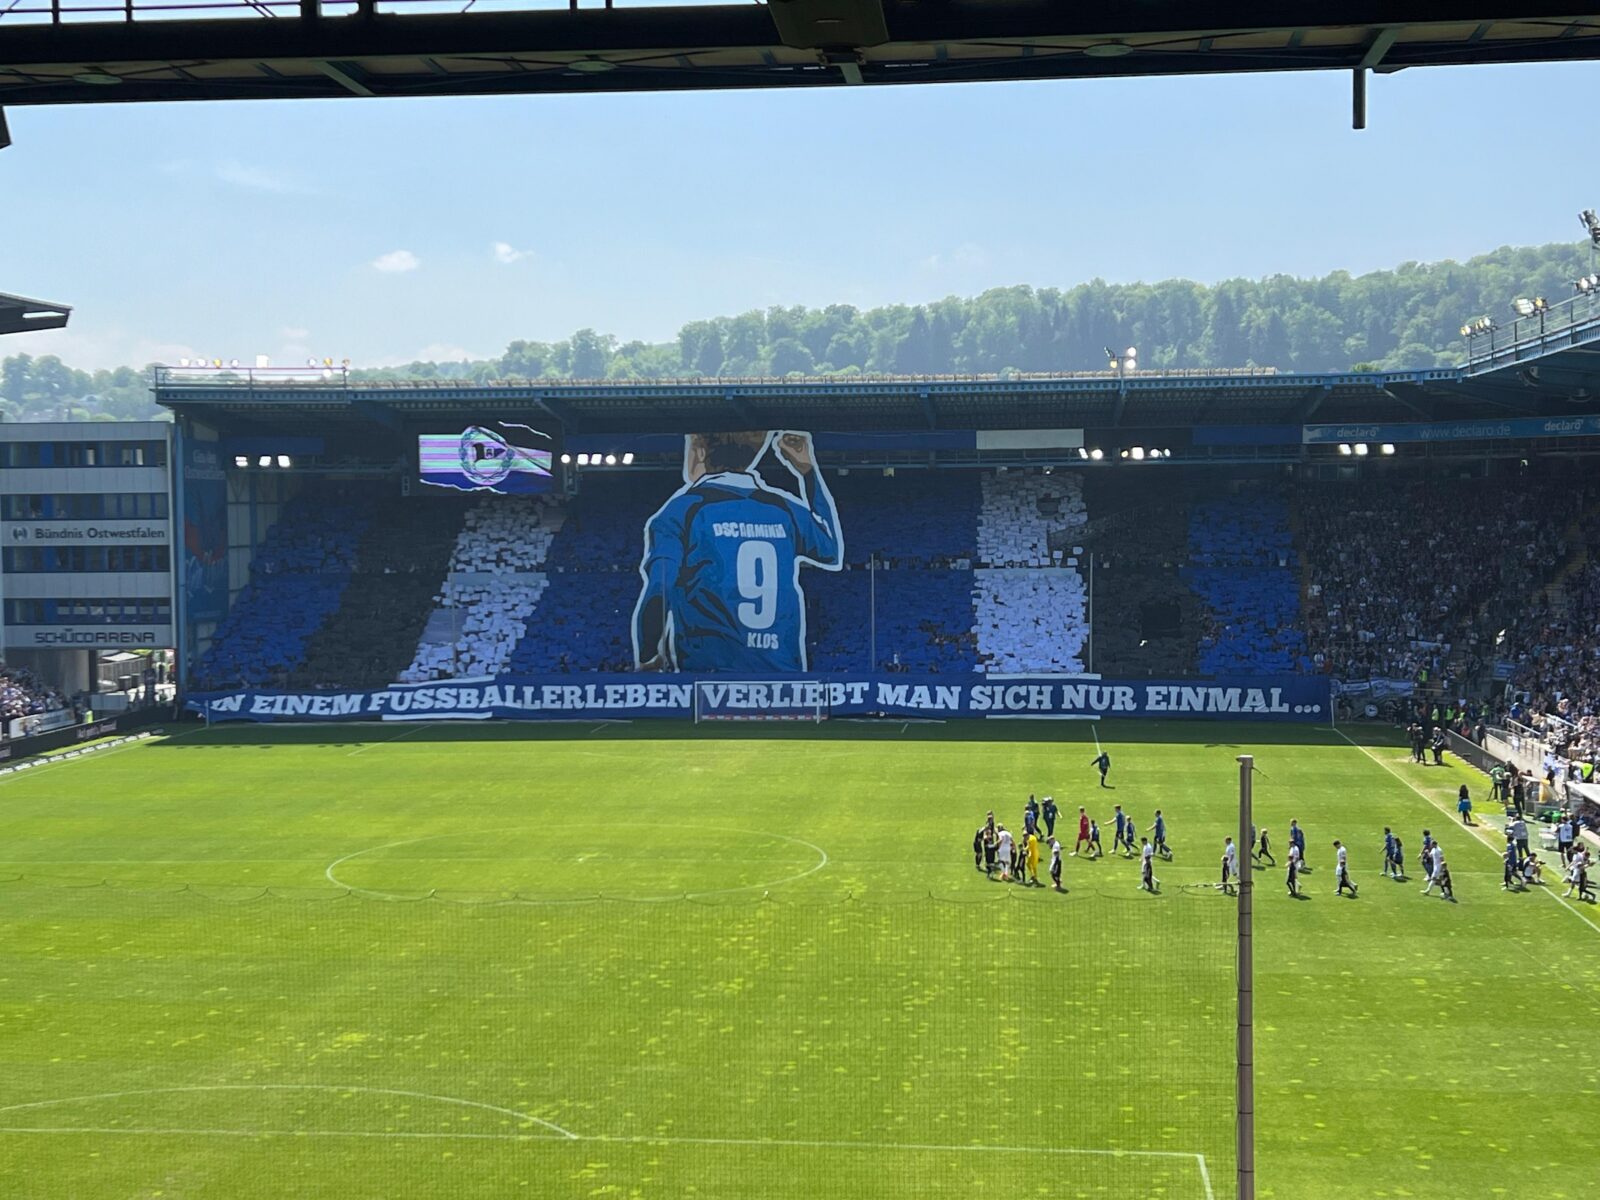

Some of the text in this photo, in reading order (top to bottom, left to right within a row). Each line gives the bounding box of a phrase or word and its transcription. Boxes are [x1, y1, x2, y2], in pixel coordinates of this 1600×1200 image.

[35, 527, 165, 539] Bündnis Ostwestfalen
[713, 522, 739, 538] DSC
[736, 540, 778, 629] 9
[747, 632, 779, 649] KLOS
[250, 694, 364, 715] EINEM
[368, 684, 693, 711] FUSSBALLERLEBEN
[701, 682, 869, 708] VERLIEBT
[876, 682, 961, 710] MAN
[970, 685, 1052, 710] SICH
[1062, 684, 1137, 711] NUR
